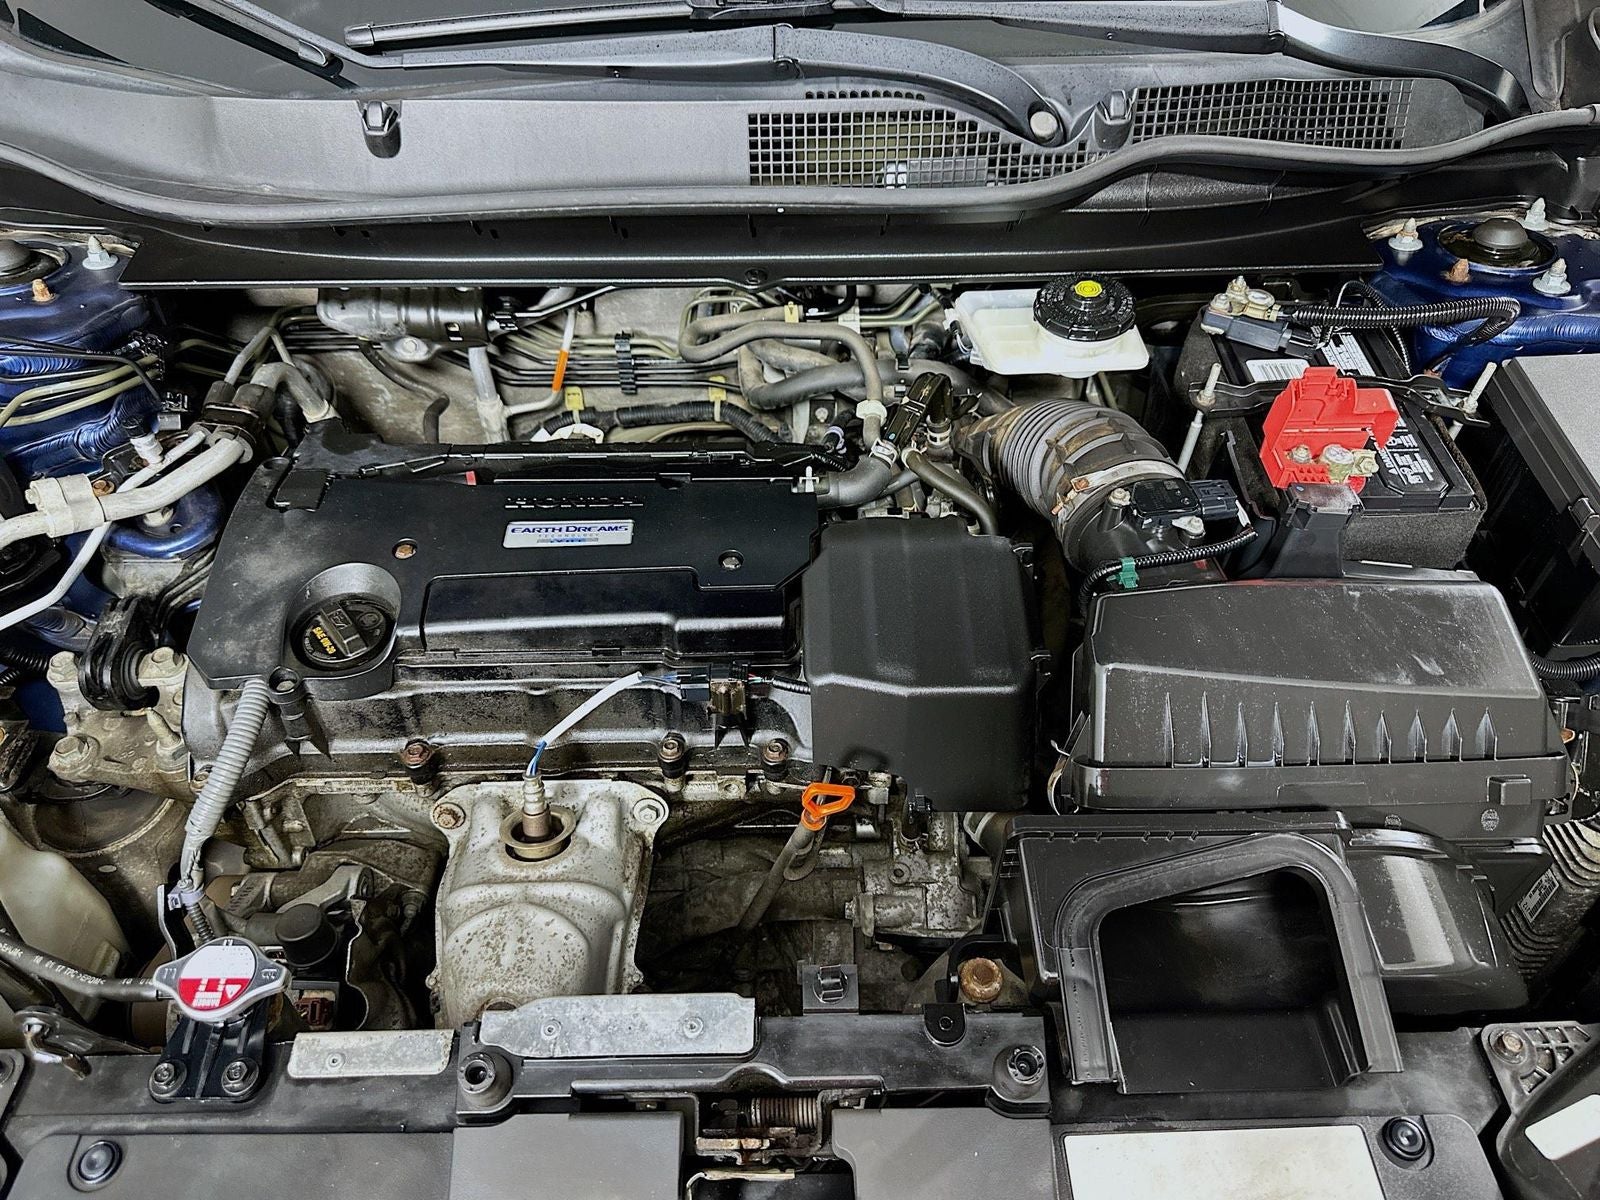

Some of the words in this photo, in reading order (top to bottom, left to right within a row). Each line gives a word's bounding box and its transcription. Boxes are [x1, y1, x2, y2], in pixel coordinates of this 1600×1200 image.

[565, 525, 629, 533] DREAMS
[312, 626, 327, 640] SAE
[320, 637, 336, 654] 0W-20
